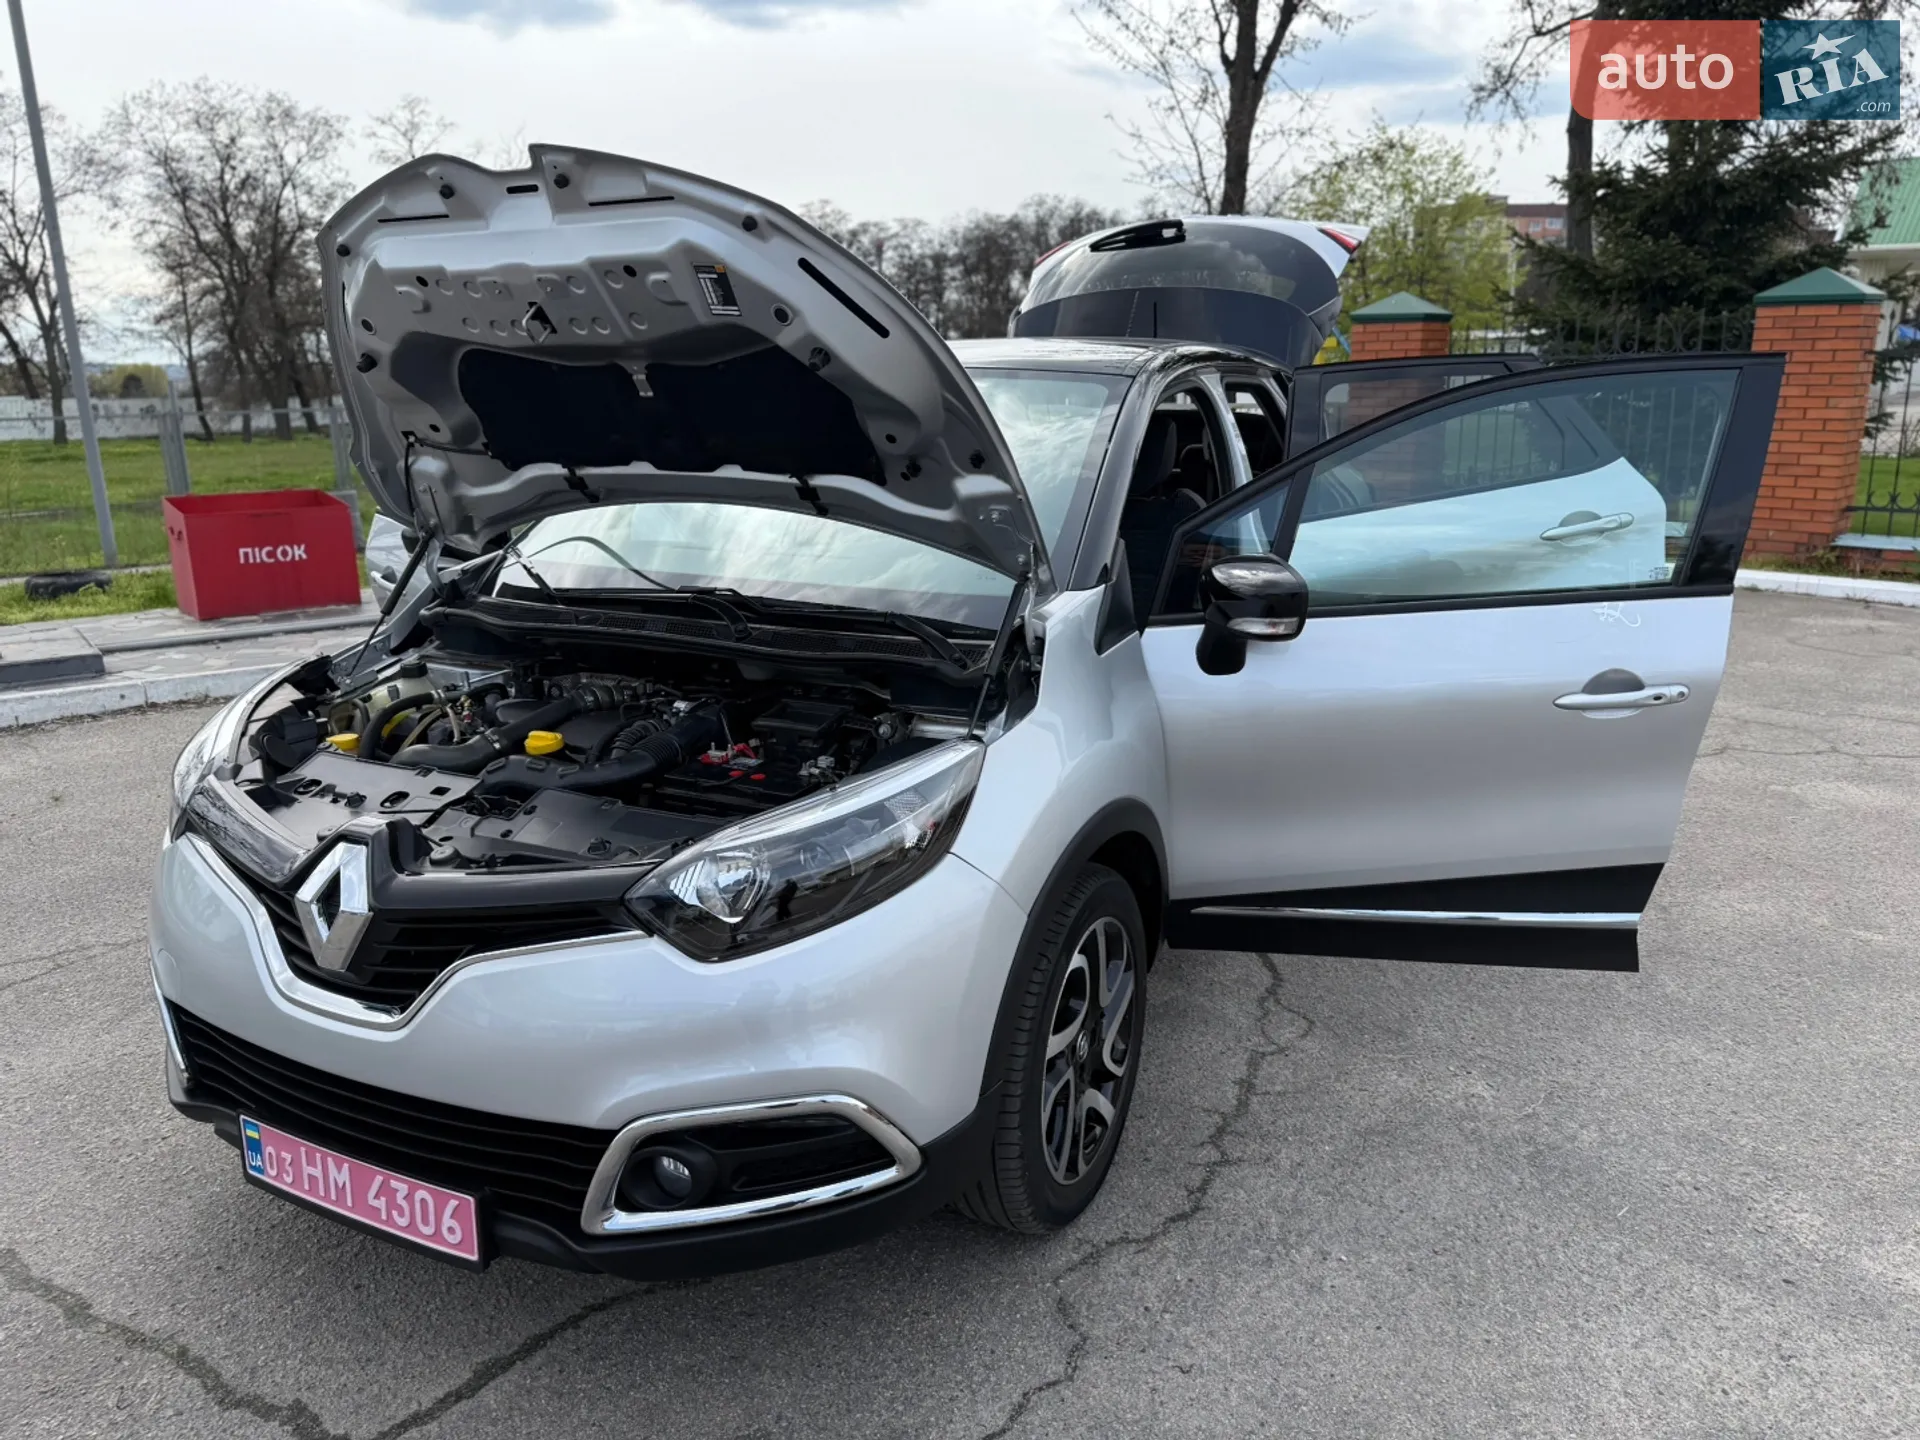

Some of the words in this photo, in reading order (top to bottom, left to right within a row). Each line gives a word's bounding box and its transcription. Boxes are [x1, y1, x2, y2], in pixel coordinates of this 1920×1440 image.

[239, 544, 307, 564] ПІСОК
[248, 1150, 263, 1169] UA
[265, 1146, 294, 1184] 03
[300, 1146, 352, 1207] HM
[367, 1175, 462, 1244] 4306
